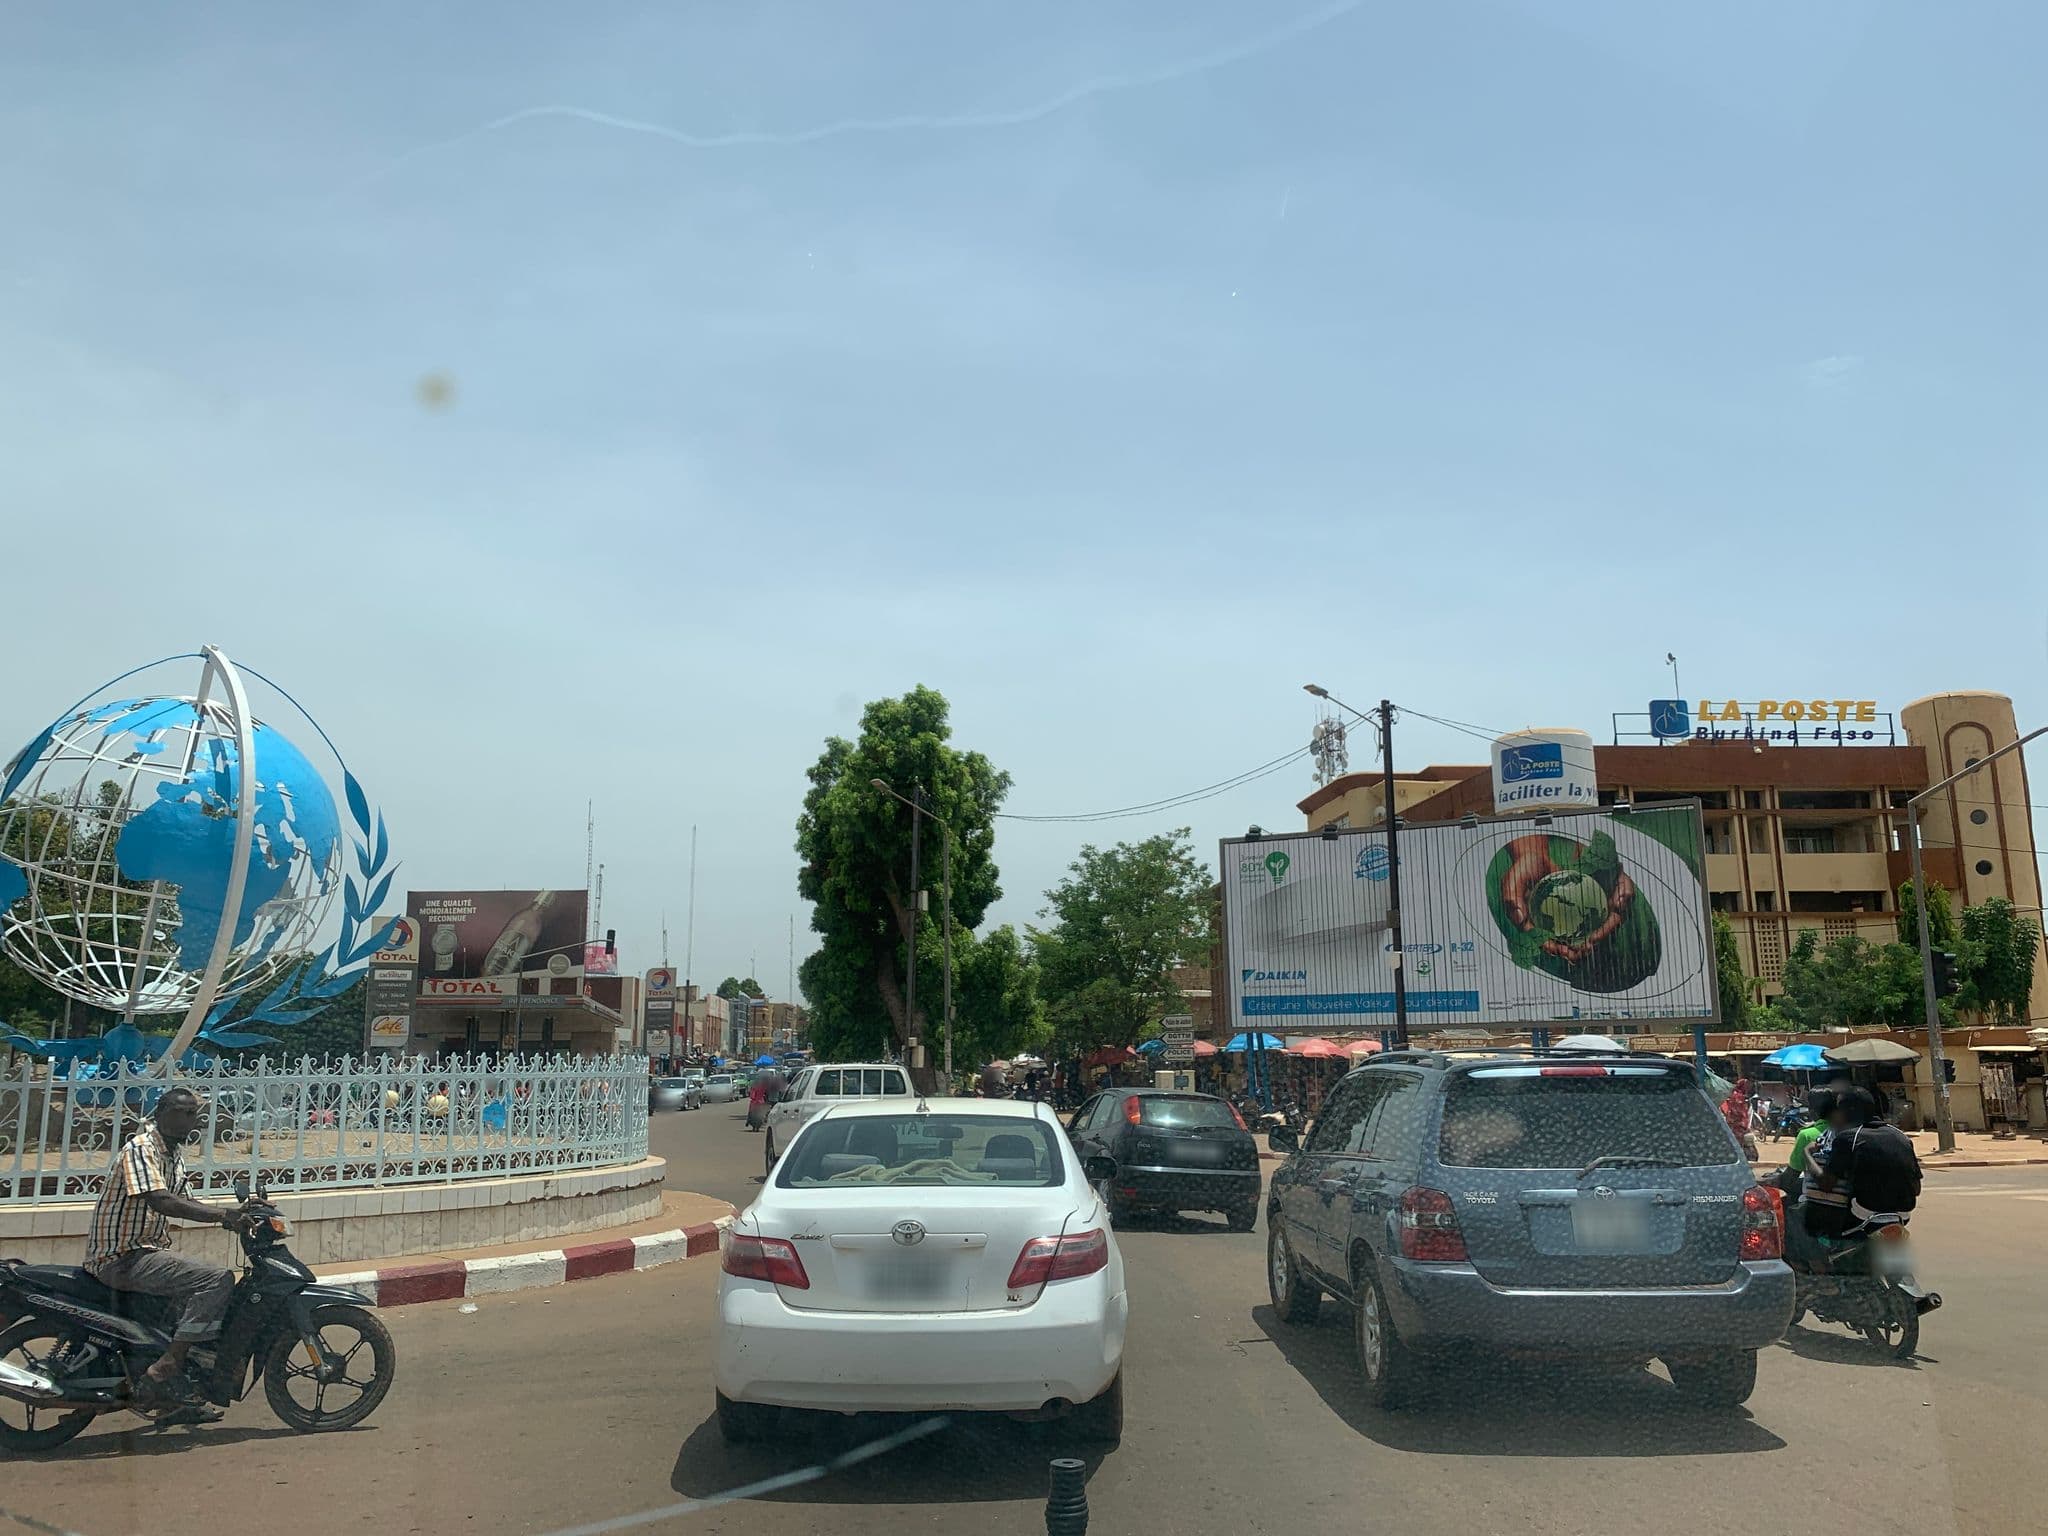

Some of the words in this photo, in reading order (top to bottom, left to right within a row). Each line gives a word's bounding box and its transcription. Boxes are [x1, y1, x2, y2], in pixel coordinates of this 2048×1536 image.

[1697, 700, 1742, 722] LA
[1757, 700, 1876, 722] POSTE
[1696, 726, 1798, 740] Burkina
[1814, 727, 1874, 740] Faso
[1568, 783, 1582, 796] la
[443, 899, 472, 907] QUALITÉ
[419, 907, 477, 915] MONDIALEMENT
[374, 952, 417, 961] TOTAL
[1255, 970, 1307, 980] DAIKIN
[429, 978, 502, 994] TOTAL
